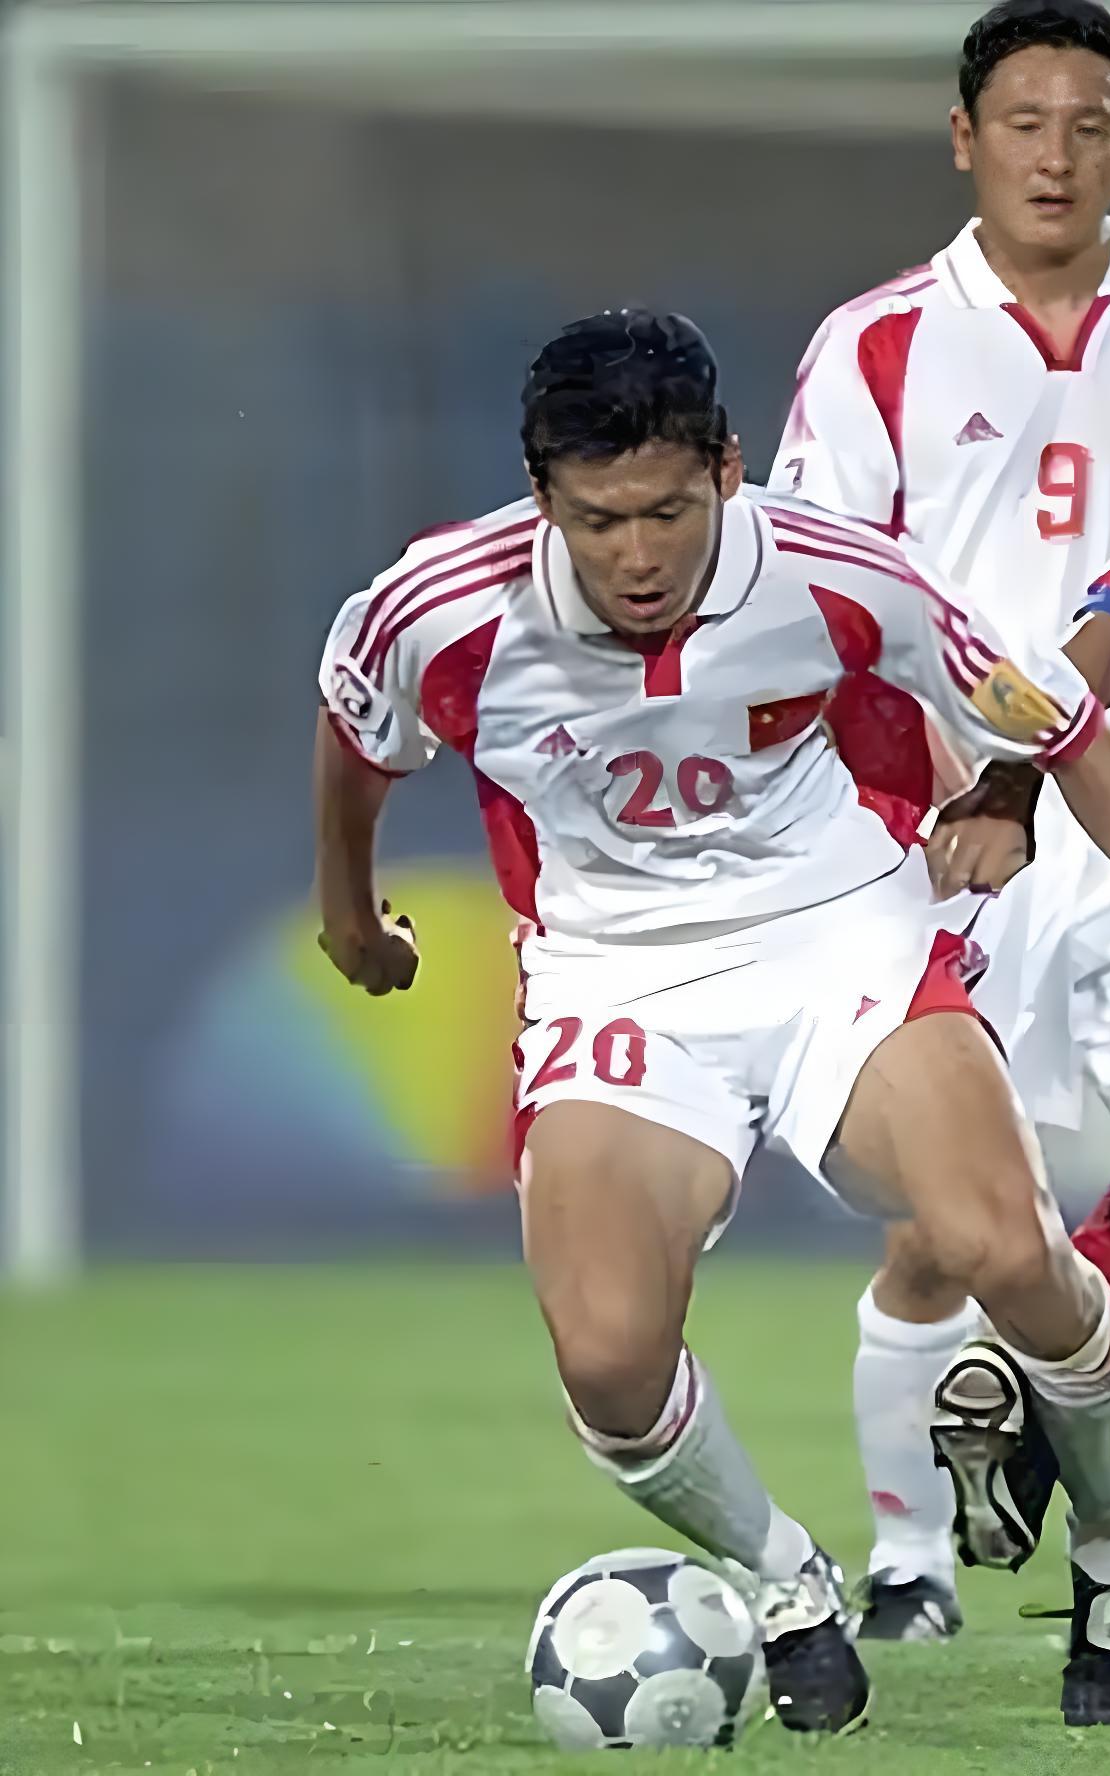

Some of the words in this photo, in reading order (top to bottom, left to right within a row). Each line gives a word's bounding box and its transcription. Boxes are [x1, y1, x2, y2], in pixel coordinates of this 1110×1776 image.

[1037, 442, 1088, 540] 9
[605, 750, 735, 828] 20
[525, 1016, 647, 1096] 20
